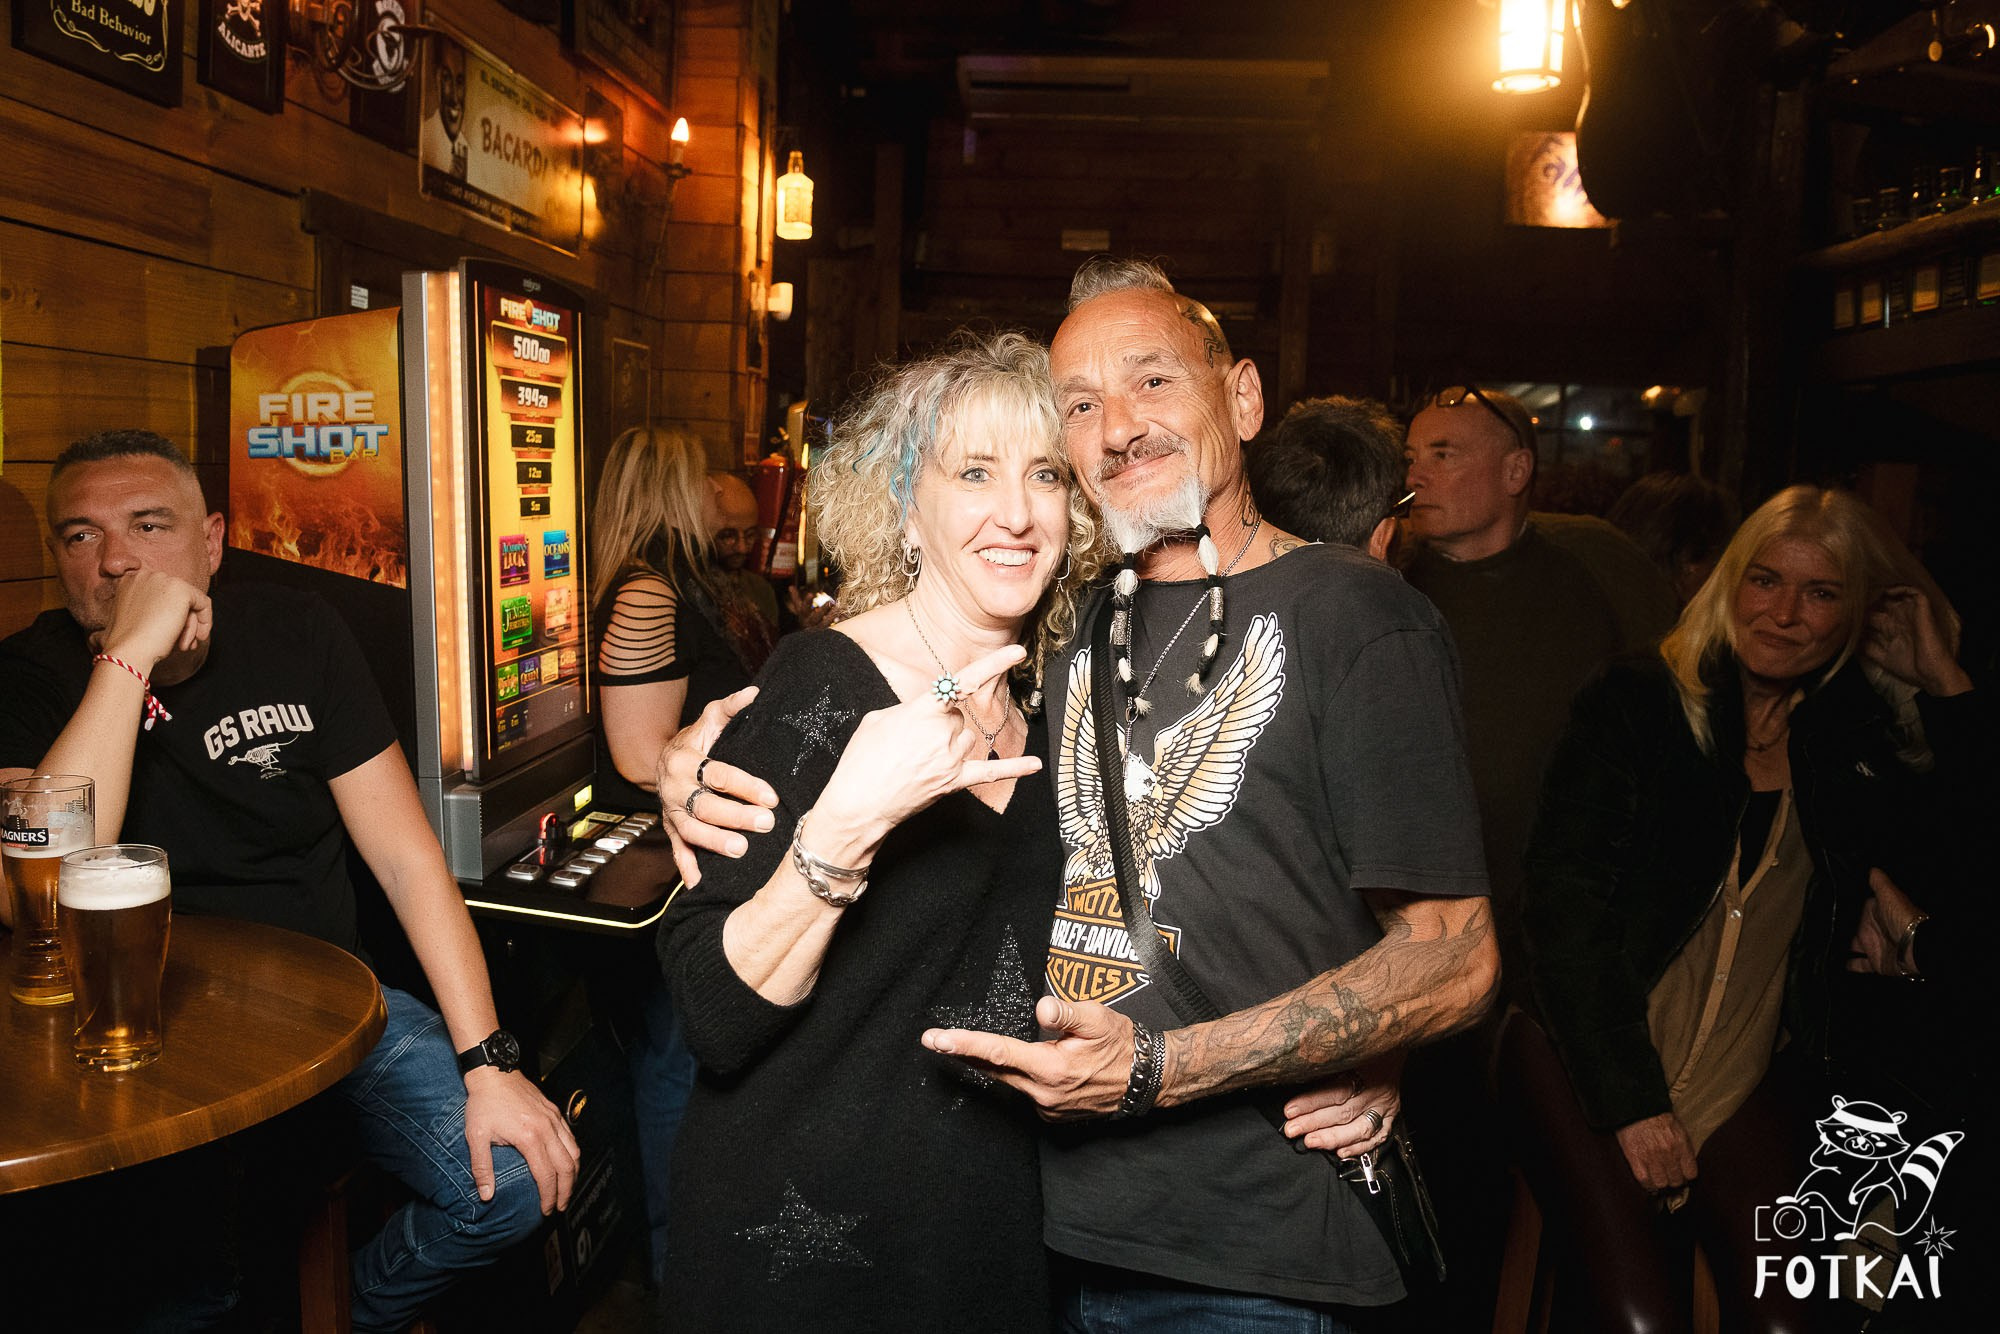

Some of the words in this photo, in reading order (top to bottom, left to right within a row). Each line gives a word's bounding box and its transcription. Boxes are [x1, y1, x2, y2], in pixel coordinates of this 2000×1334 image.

[72, 0, 95, 20] Bad
[100, 7, 151, 45] Behavior
[218, 22, 266, 57] ALICANTE
[501, 298, 526, 321] FIRE
[532, 308, 560, 330] SHOT
[258, 391, 376, 426] FIRE
[247, 424, 389, 458] SHOT
[330, 450, 377, 463] BAR
[204, 715, 240, 760] GS
[238, 703, 315, 740] RAW
[1073, 885, 1123, 918] MOTO
[1053, 956, 1122, 1001] CYCLES
